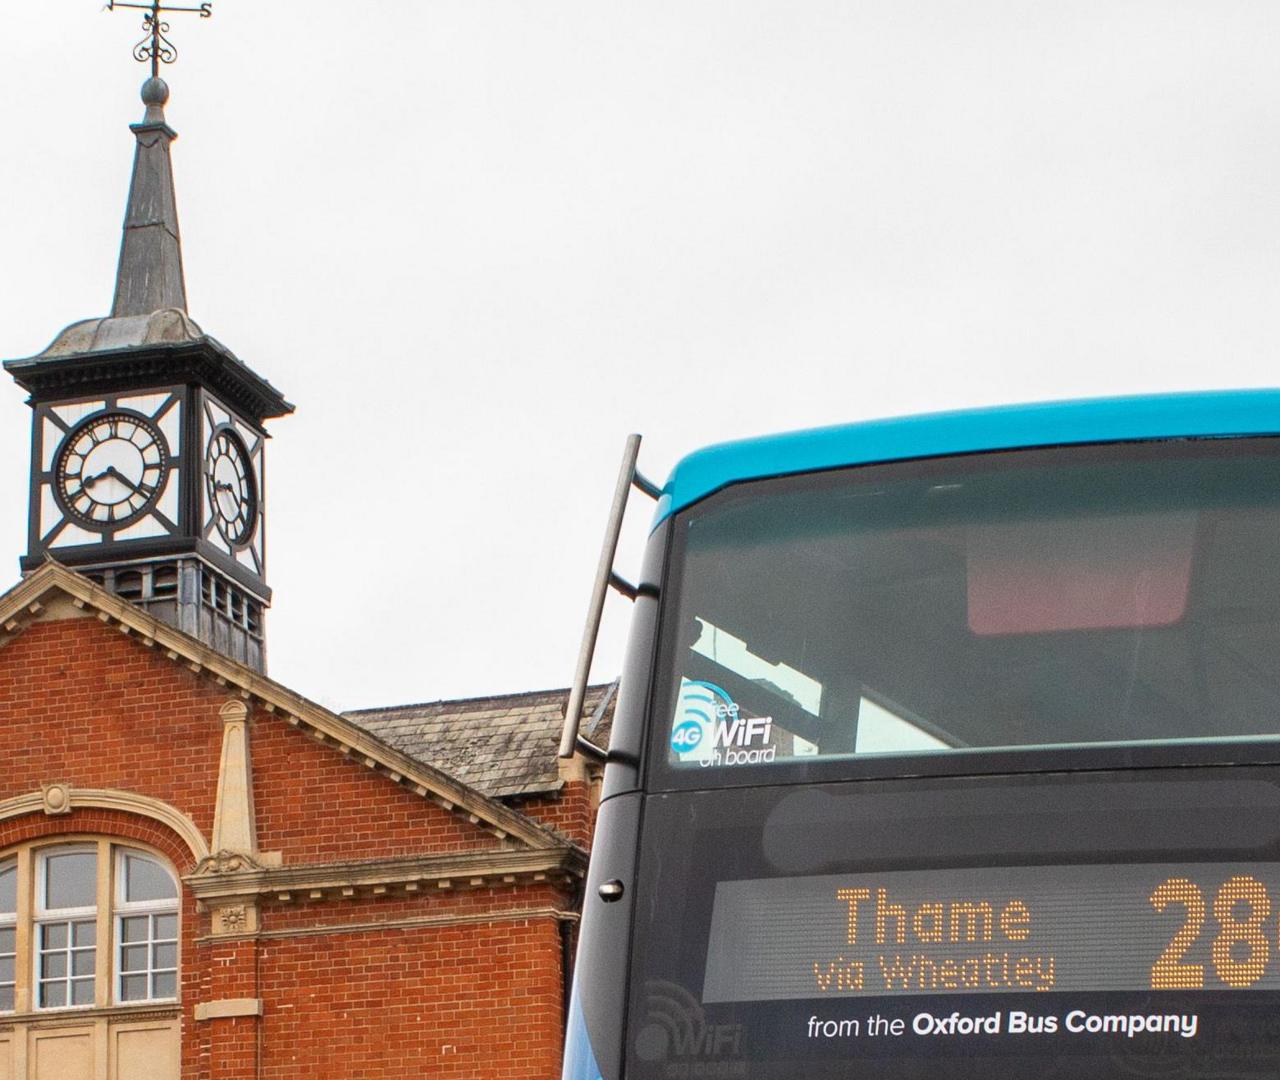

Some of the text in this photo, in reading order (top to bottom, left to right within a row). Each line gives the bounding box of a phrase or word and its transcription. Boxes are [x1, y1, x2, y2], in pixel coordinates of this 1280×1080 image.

[672, 717, 772, 748] 4G WiFi
[725, 744, 777, 766] board
[837, 888, 1031, 944] Thame
[814, 952, 1055, 992] via Wheatley
[807, 1009, 1198, 1038] from the Oxford Bus Company
